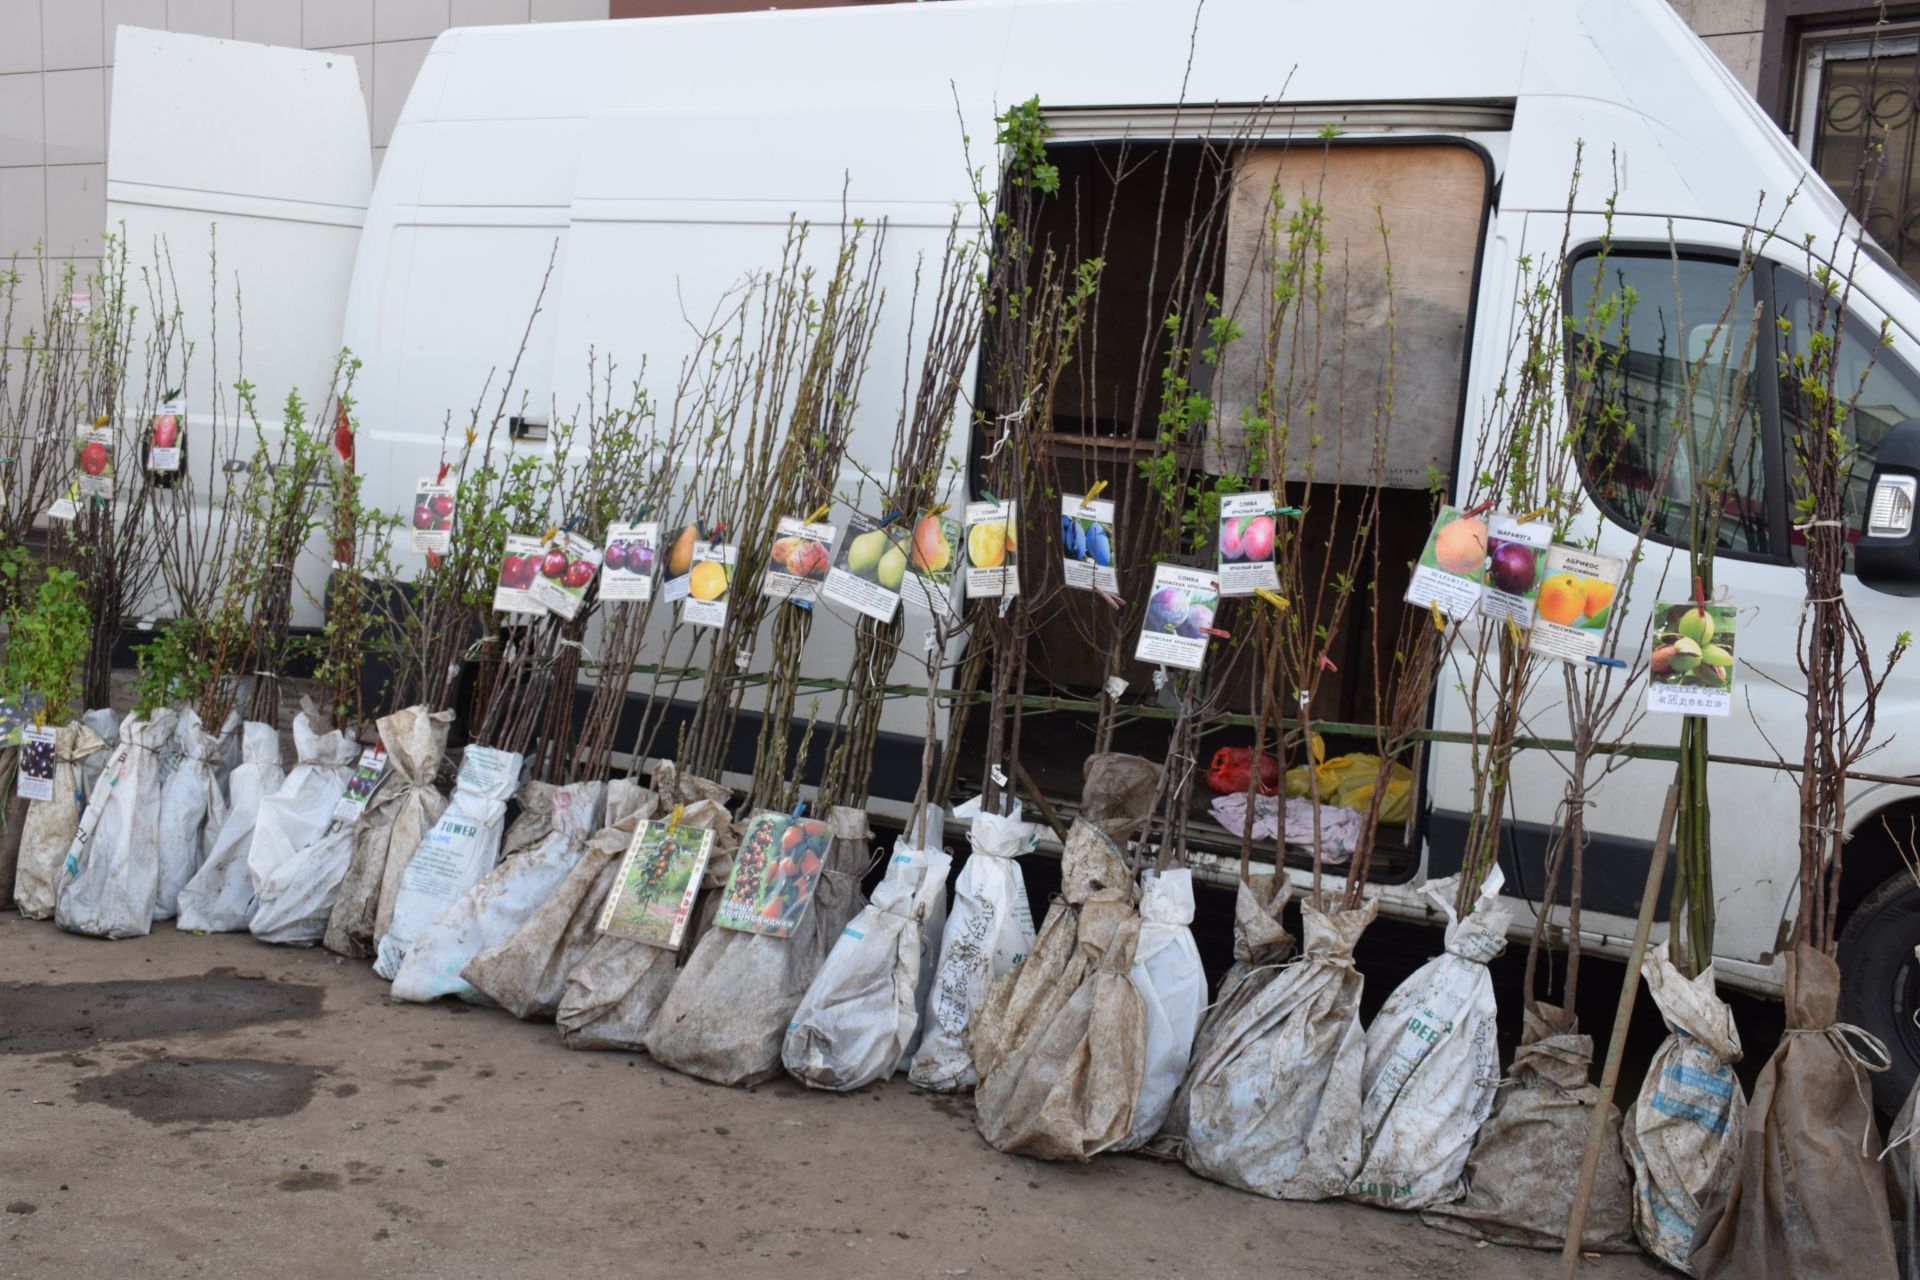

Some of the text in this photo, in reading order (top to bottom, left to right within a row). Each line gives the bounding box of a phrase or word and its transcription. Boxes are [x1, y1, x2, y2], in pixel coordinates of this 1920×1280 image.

[1497, 529, 1532, 541] ШАРАФУГА
[1566, 557, 1600, 570] АБРИКОС
[1178, 575, 1199, 583] СЛИВА
[1431, 571, 1469, 588] ШАРАФУГА
[441, 821, 477, 838] TOWER
